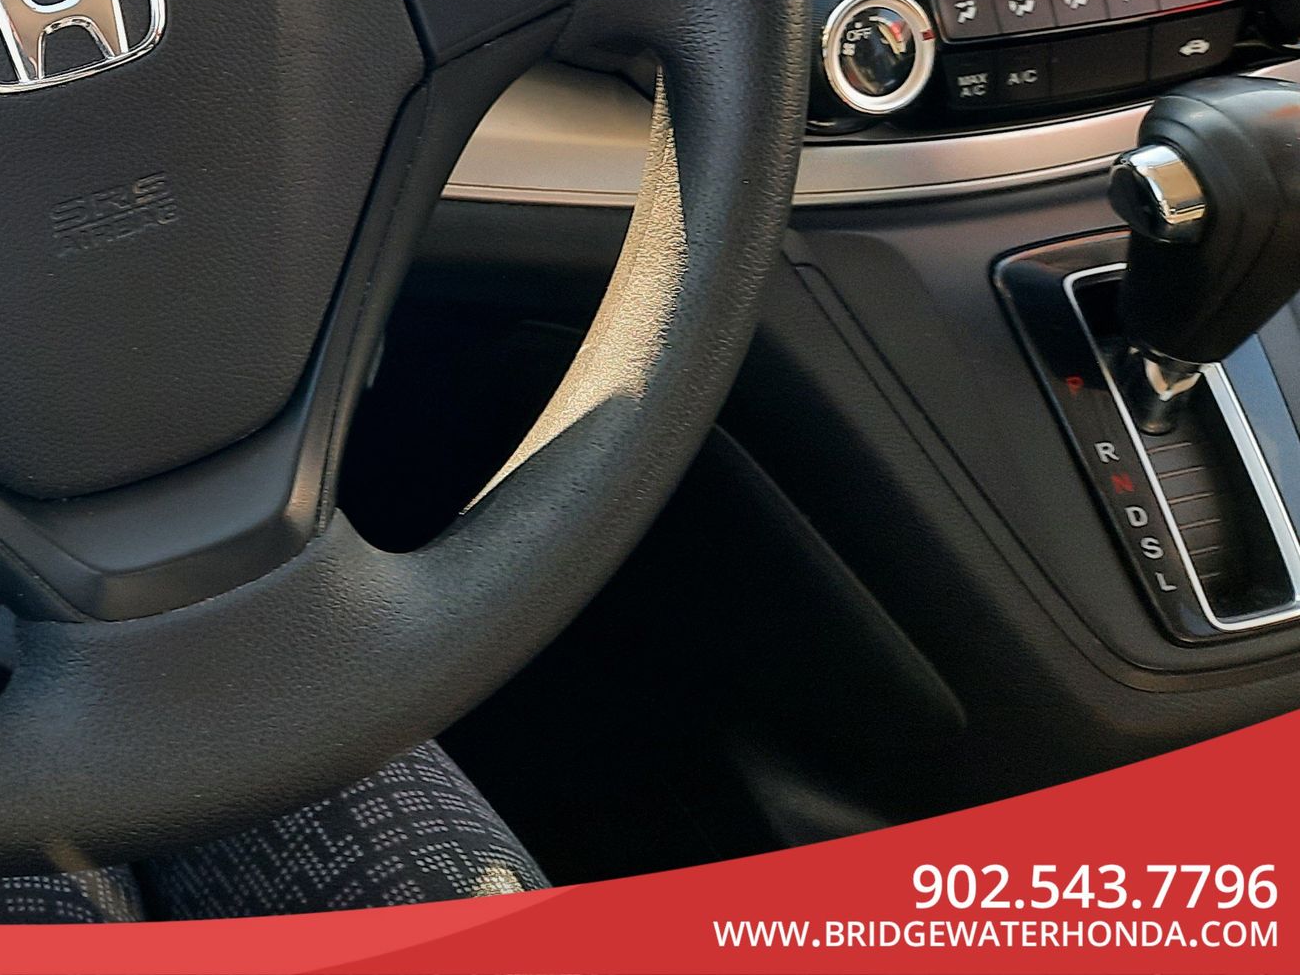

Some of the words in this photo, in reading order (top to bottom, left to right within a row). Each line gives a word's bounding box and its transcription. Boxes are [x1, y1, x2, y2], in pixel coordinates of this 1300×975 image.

[846, 26, 873, 42] OFF
[956, 72, 988, 87] MAX
[1006, 68, 1039, 86] A/C
[959, 84, 988, 98] A/C
[1066, 376, 1084, 397] P
[1094, 441, 1120, 463] R
[1111, 473, 1134, 494] N
[1124, 506, 1148, 528] D
[1140, 537, 1164, 559] S
[1155, 572, 1177, 592] L
